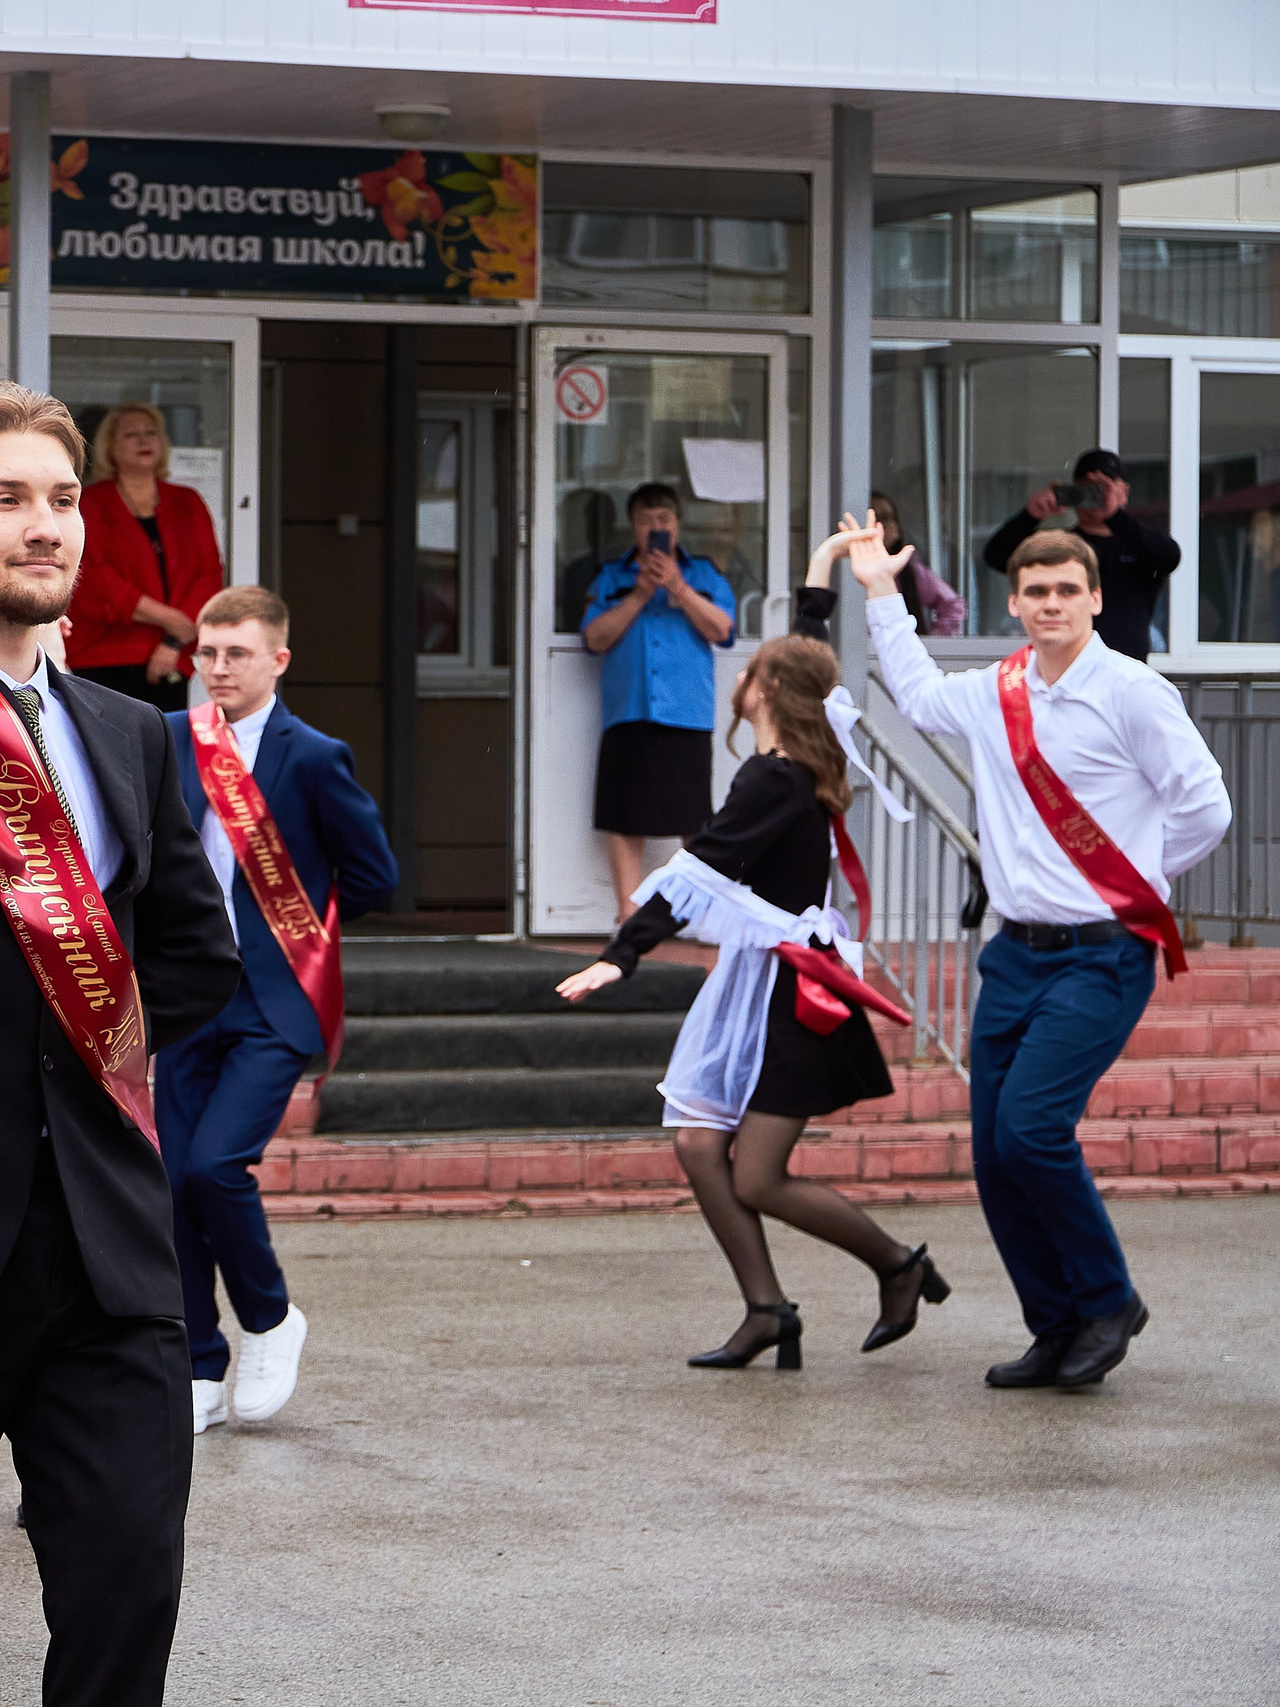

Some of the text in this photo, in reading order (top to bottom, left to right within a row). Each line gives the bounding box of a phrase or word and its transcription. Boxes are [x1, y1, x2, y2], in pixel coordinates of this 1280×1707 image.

[109, 171, 375, 227] Здравствуй,
[58, 221, 427, 269] любимая школа!
[210, 753, 284, 887] Выпускник
[272, 894, 318, 940] 2025
[4, 897, 23, 919] СОШ
[49, 818, 123, 962] Дерюгин Матвей
[14, 920, 27, 931] №
[19, 930, 33, 944] 183
[29, 952, 58, 999] Новосибирск
